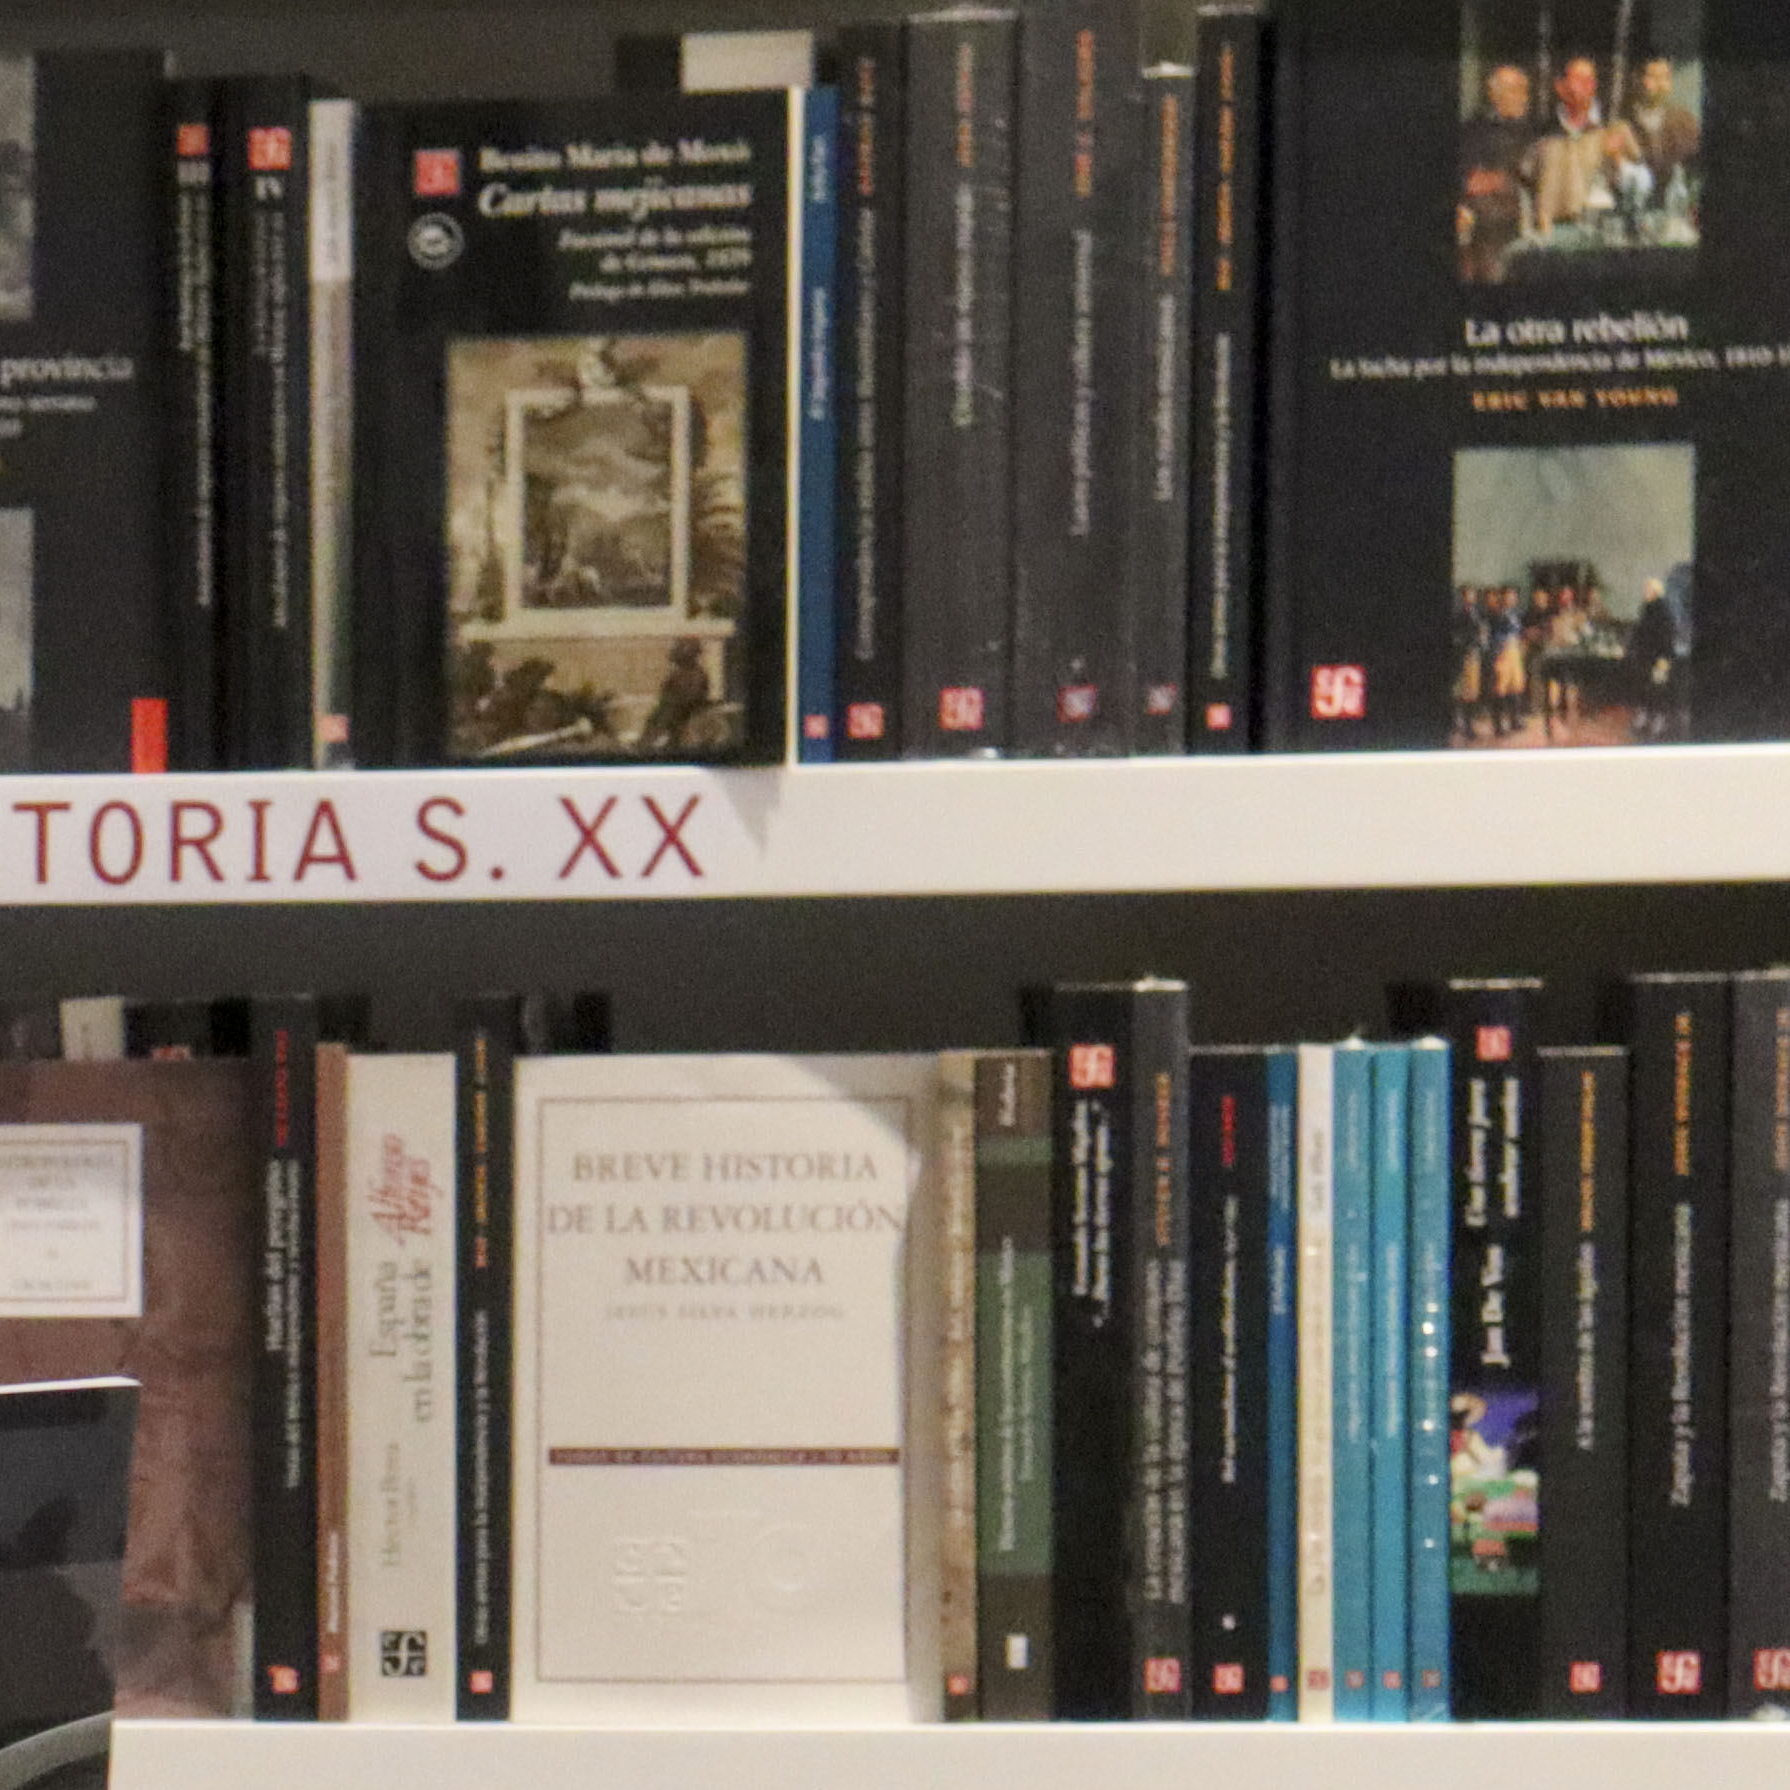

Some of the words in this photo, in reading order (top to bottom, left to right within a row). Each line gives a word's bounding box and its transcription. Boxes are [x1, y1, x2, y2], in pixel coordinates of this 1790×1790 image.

[1465, 318, 1500, 346] La
[1506, 318, 1564, 345] otra
[0, 354, 135, 388] provincia
[415, 797, 505, 880] S.
[559, 795, 707, 878] XX
[573, 1154, 685, 1180] BREVE
[704, 1152, 878, 1181] HISTORIA
[548, 1206, 593, 1233] DE
[606, 1206, 647, 1233] LA
[625, 1257, 825, 1284] MEXICANA
